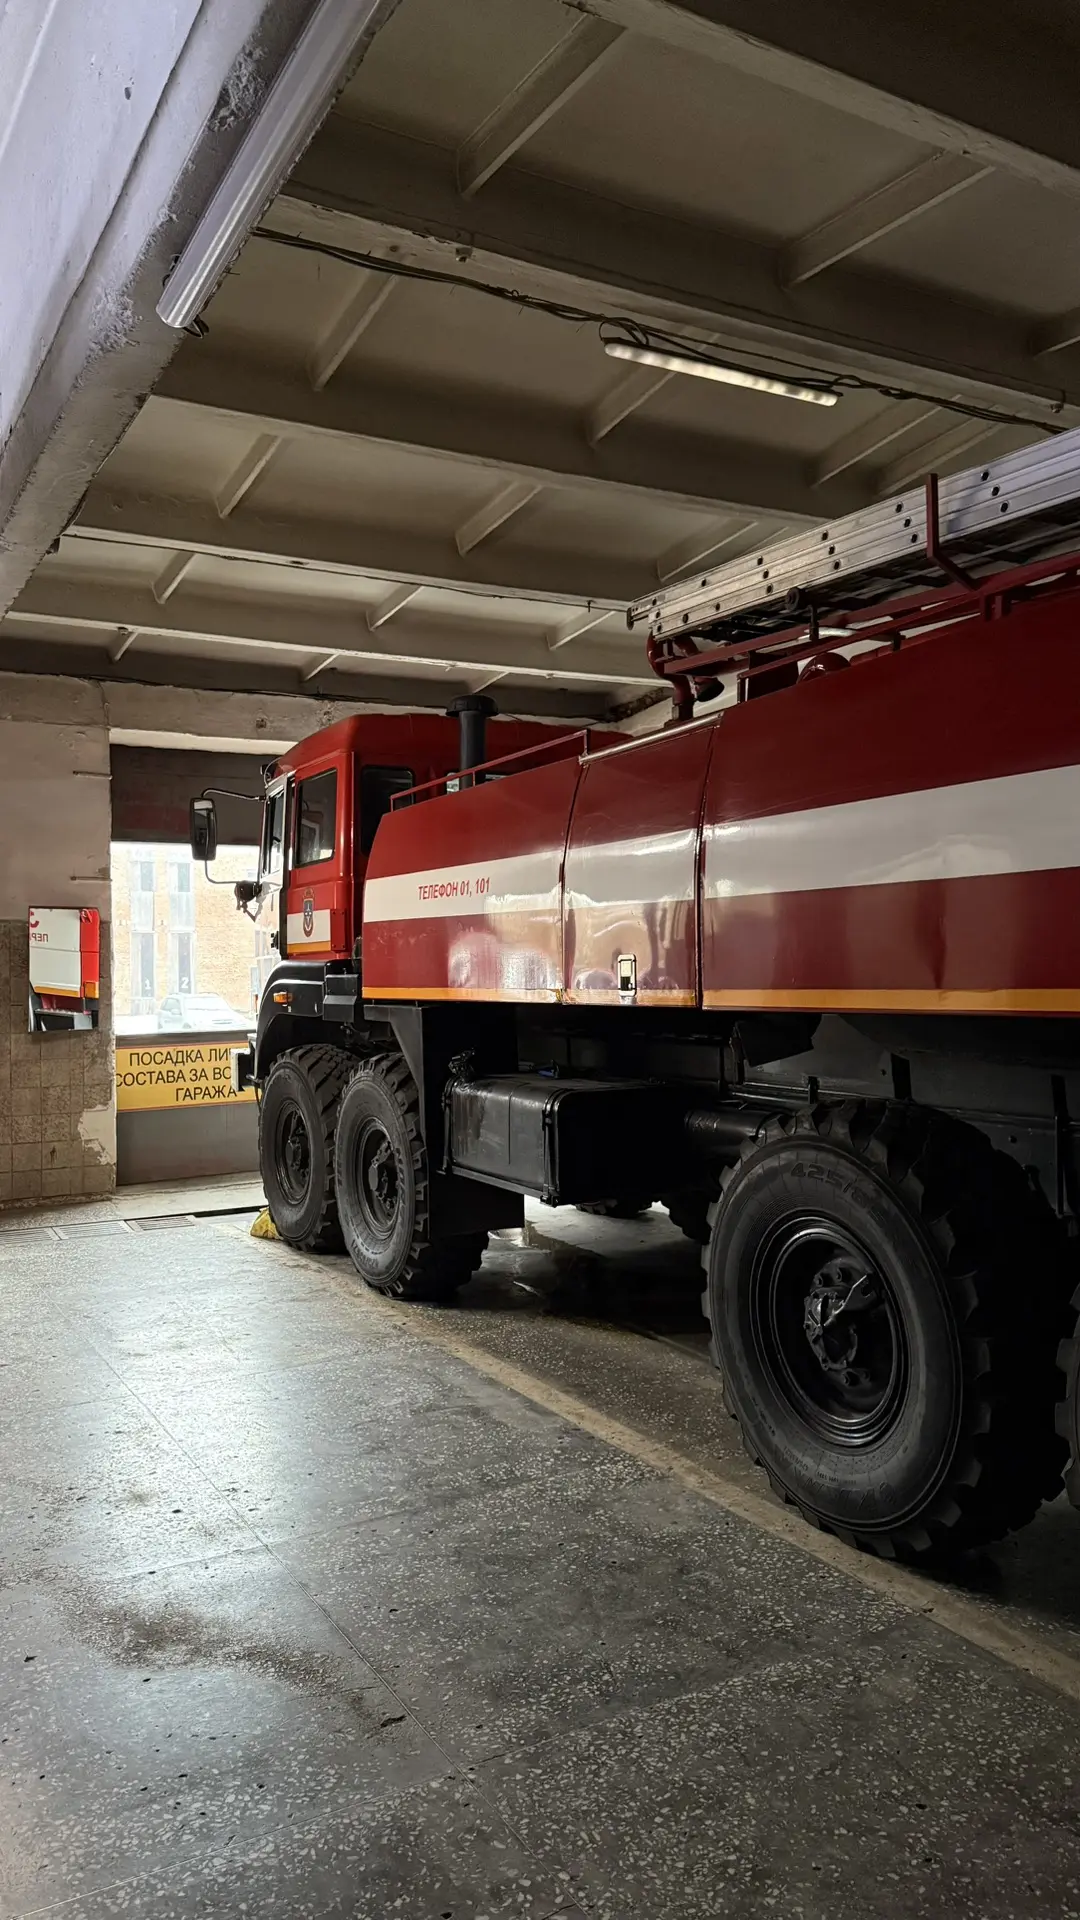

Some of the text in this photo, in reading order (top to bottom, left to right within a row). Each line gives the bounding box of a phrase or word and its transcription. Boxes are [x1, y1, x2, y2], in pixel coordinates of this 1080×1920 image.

[418, 877, 490, 900] ТЕЛЕФОН 01, 101
[181, 976, 190, 989] 2
[129, 1050, 204, 1067] ПОСАДКА
[189, 1068, 209, 1082] ЗА
[175, 1085, 237, 1102] ГАРАЖА
